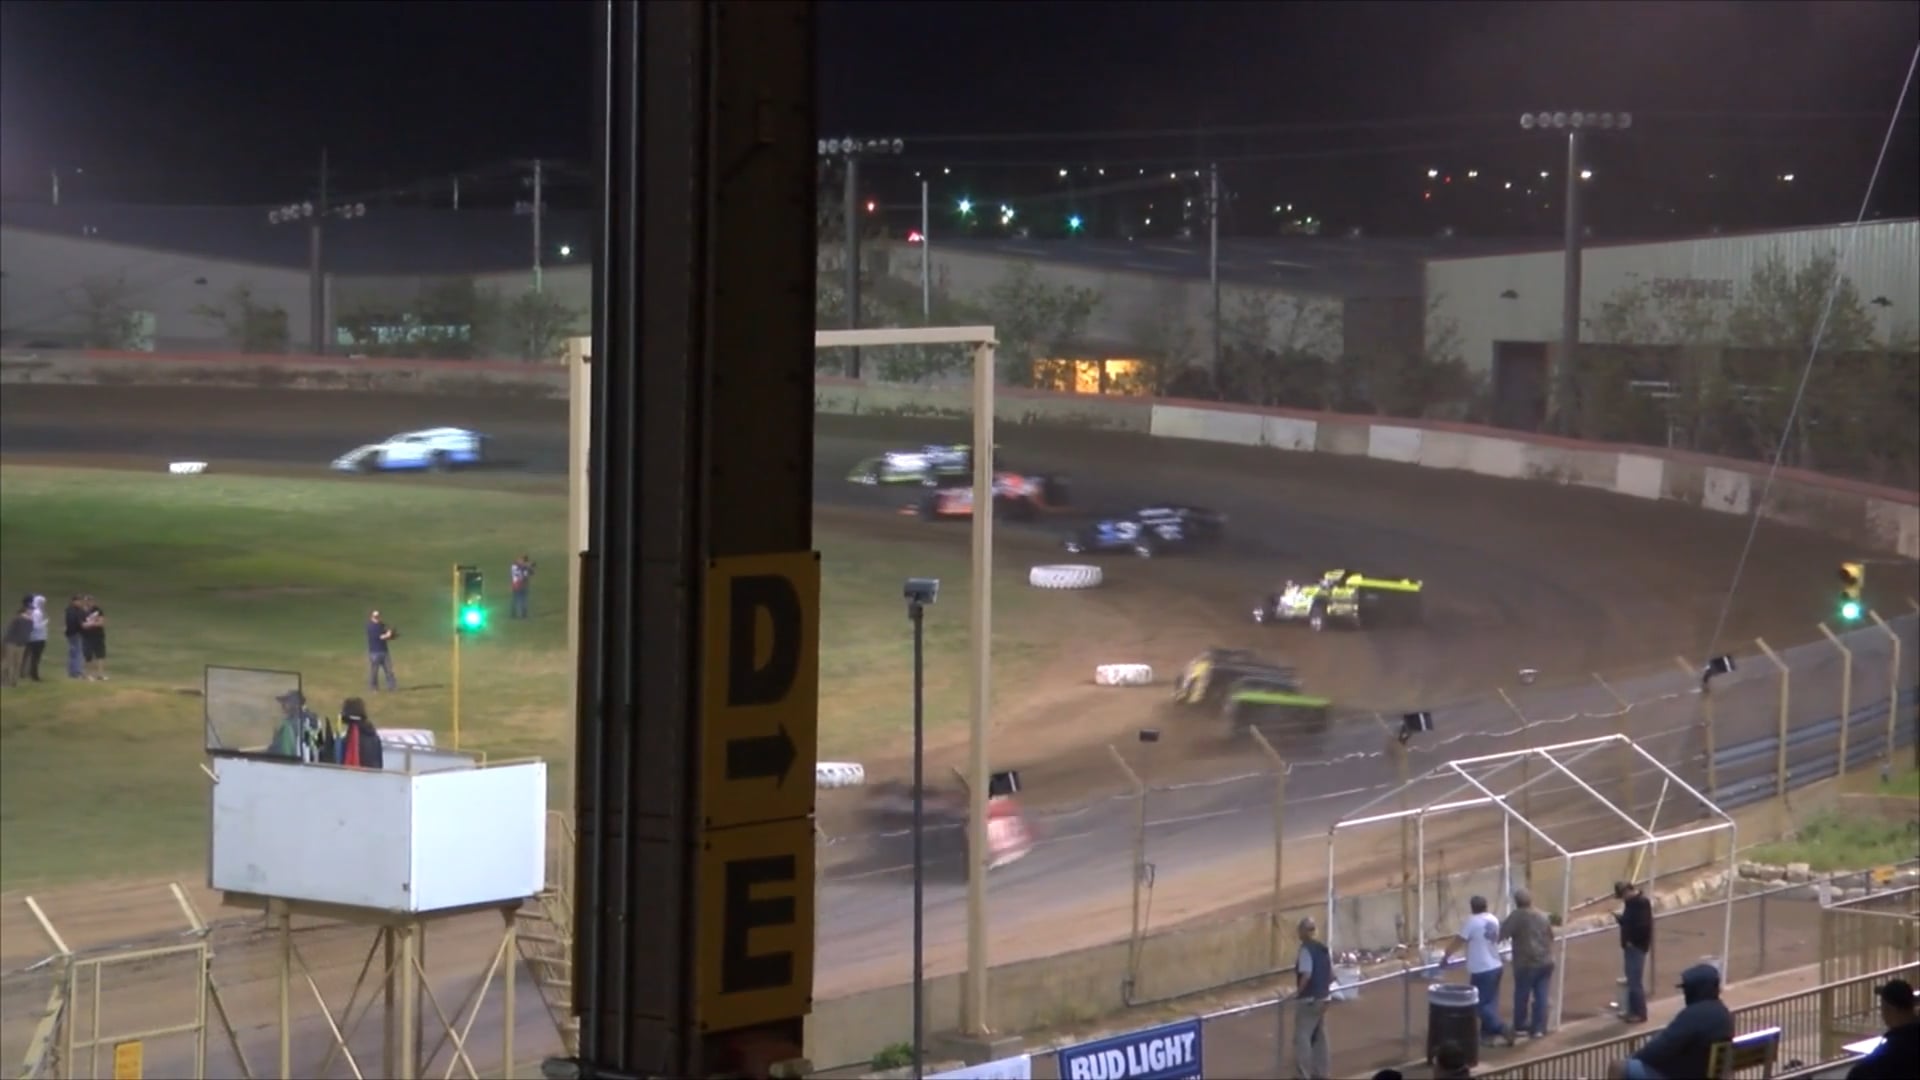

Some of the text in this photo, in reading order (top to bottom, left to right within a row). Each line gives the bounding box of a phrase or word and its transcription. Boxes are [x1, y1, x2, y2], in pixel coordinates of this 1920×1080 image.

[729, 575, 802, 706] D
[720, 855, 795, 993] E
[1070, 1048, 1126, 1079] BUD
[1126, 1031, 1195, 1076] LIGHT
